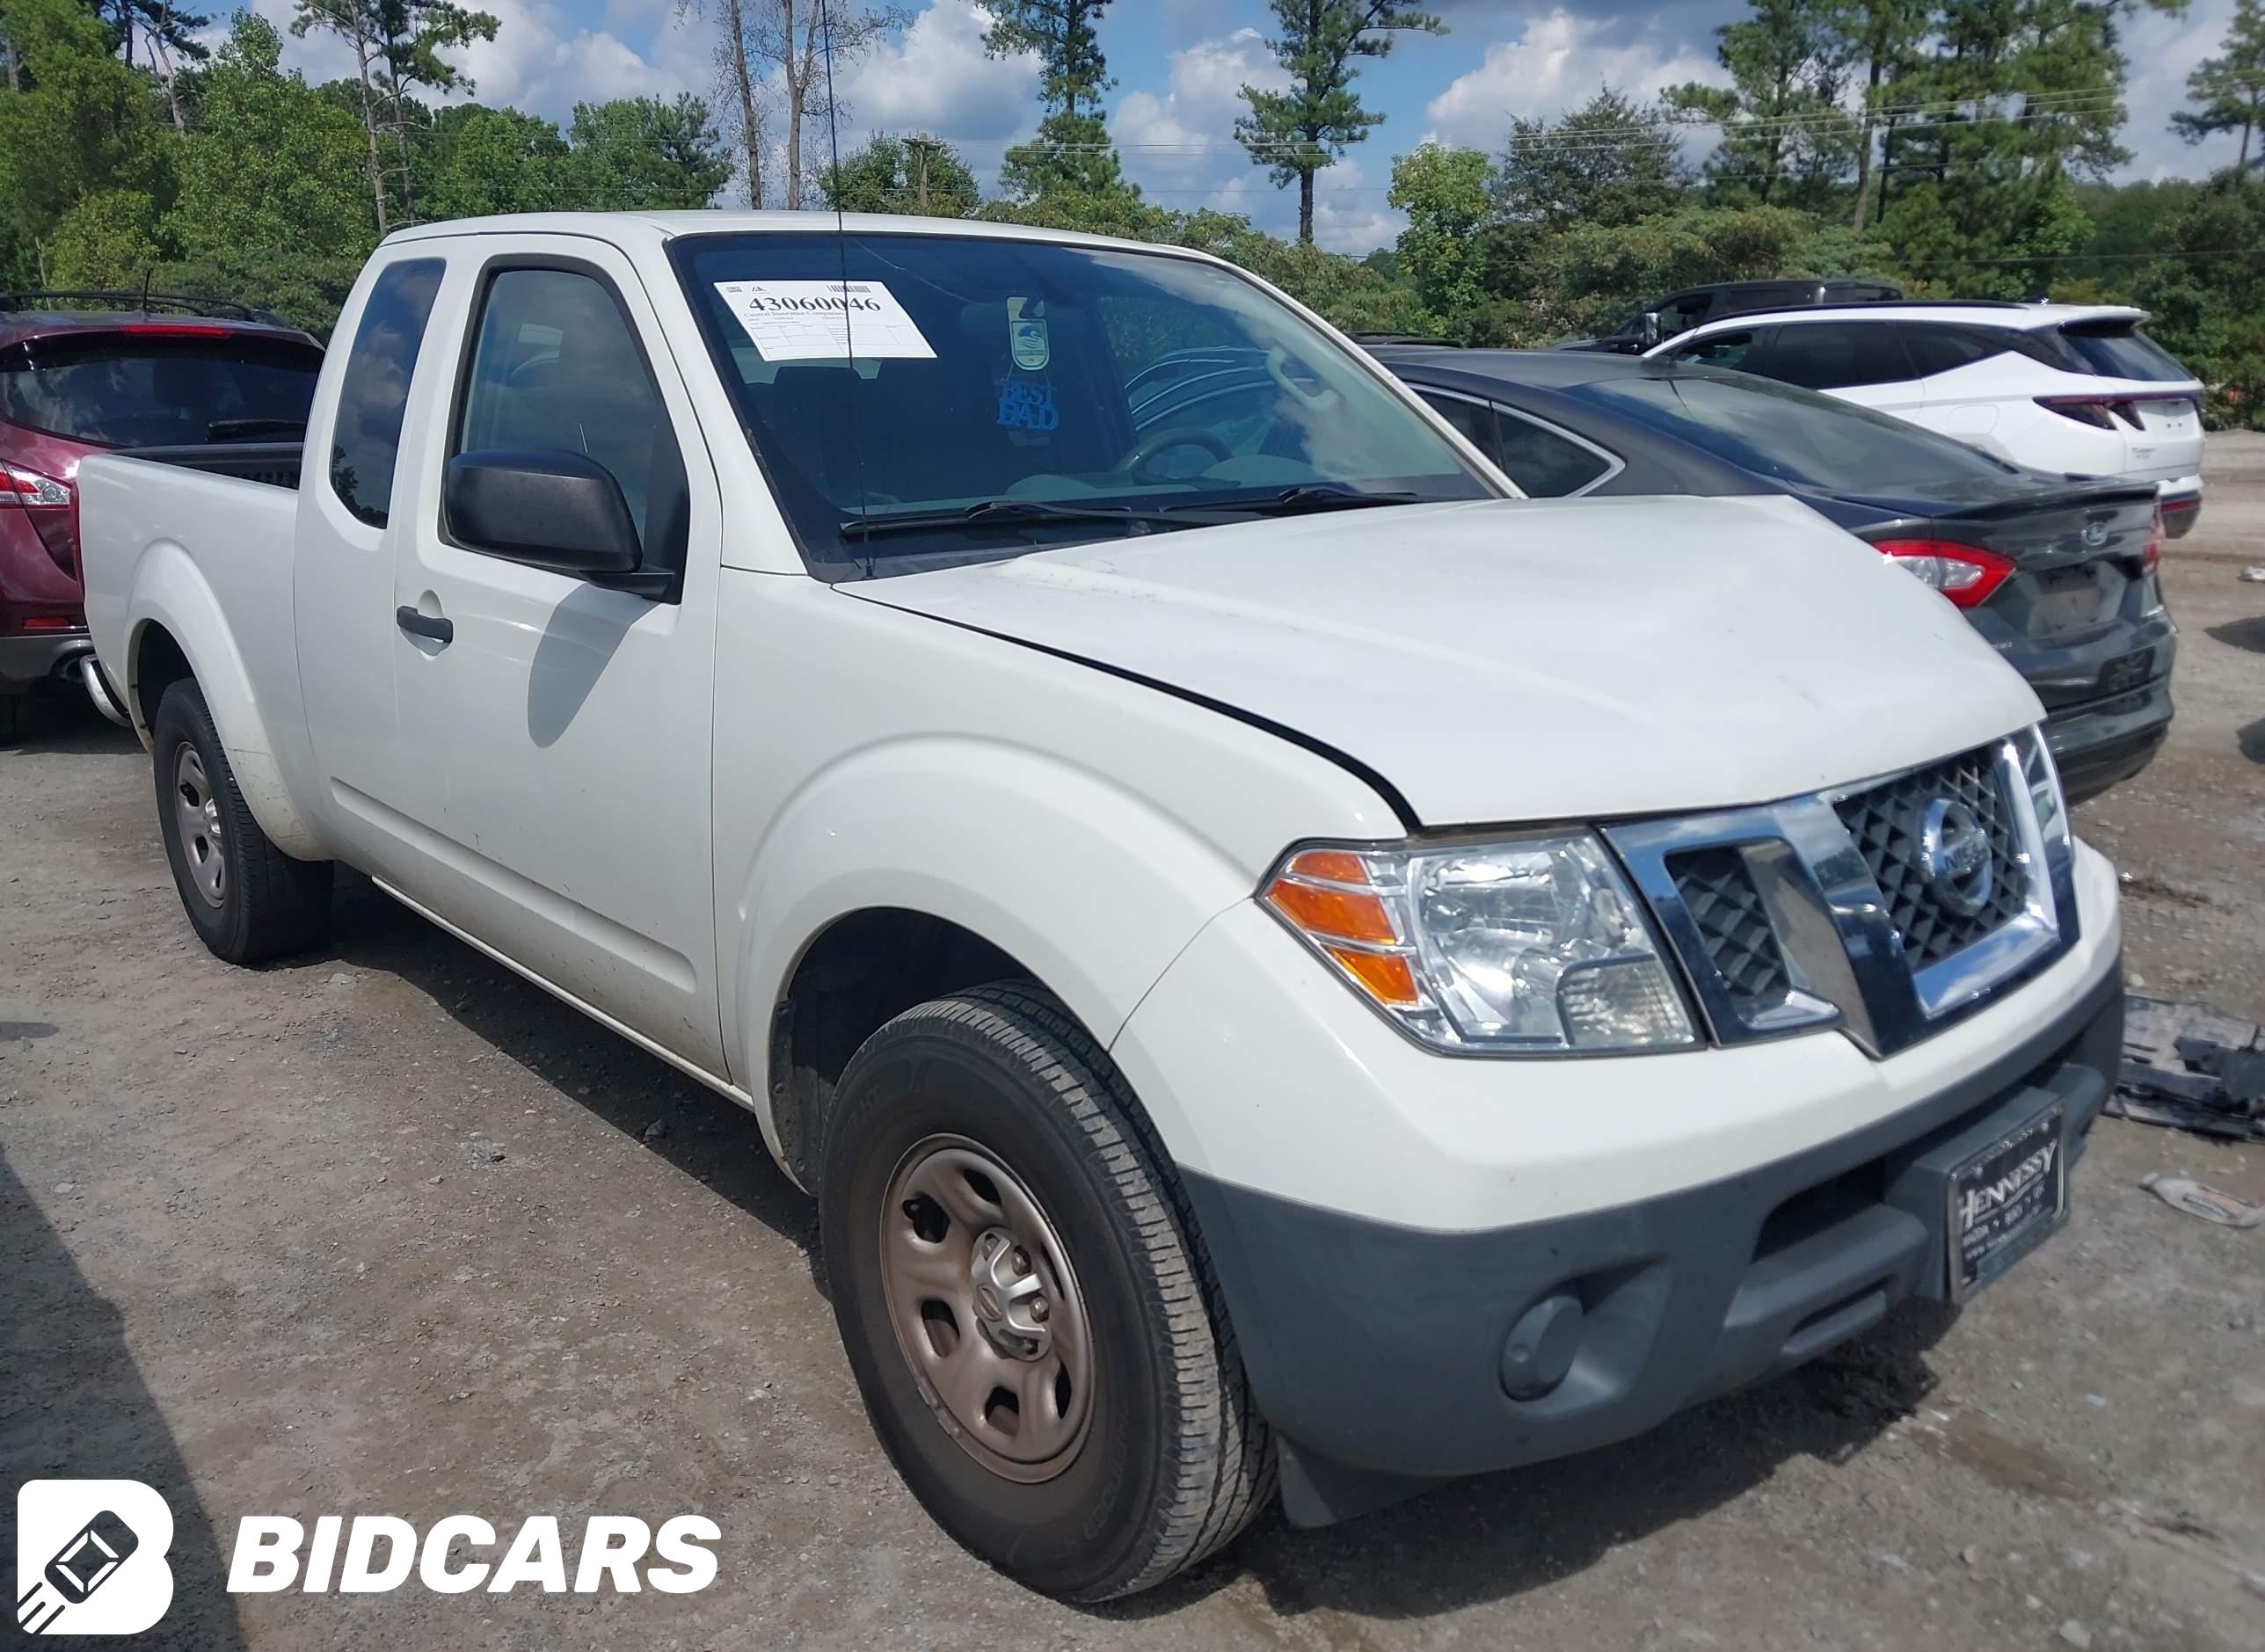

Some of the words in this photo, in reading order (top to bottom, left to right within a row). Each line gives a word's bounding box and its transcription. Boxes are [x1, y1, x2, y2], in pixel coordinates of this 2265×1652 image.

[749, 296, 881, 311] 43060046
[1001, 380, 1058, 404] BEST
[998, 397, 1060, 430] DAD
